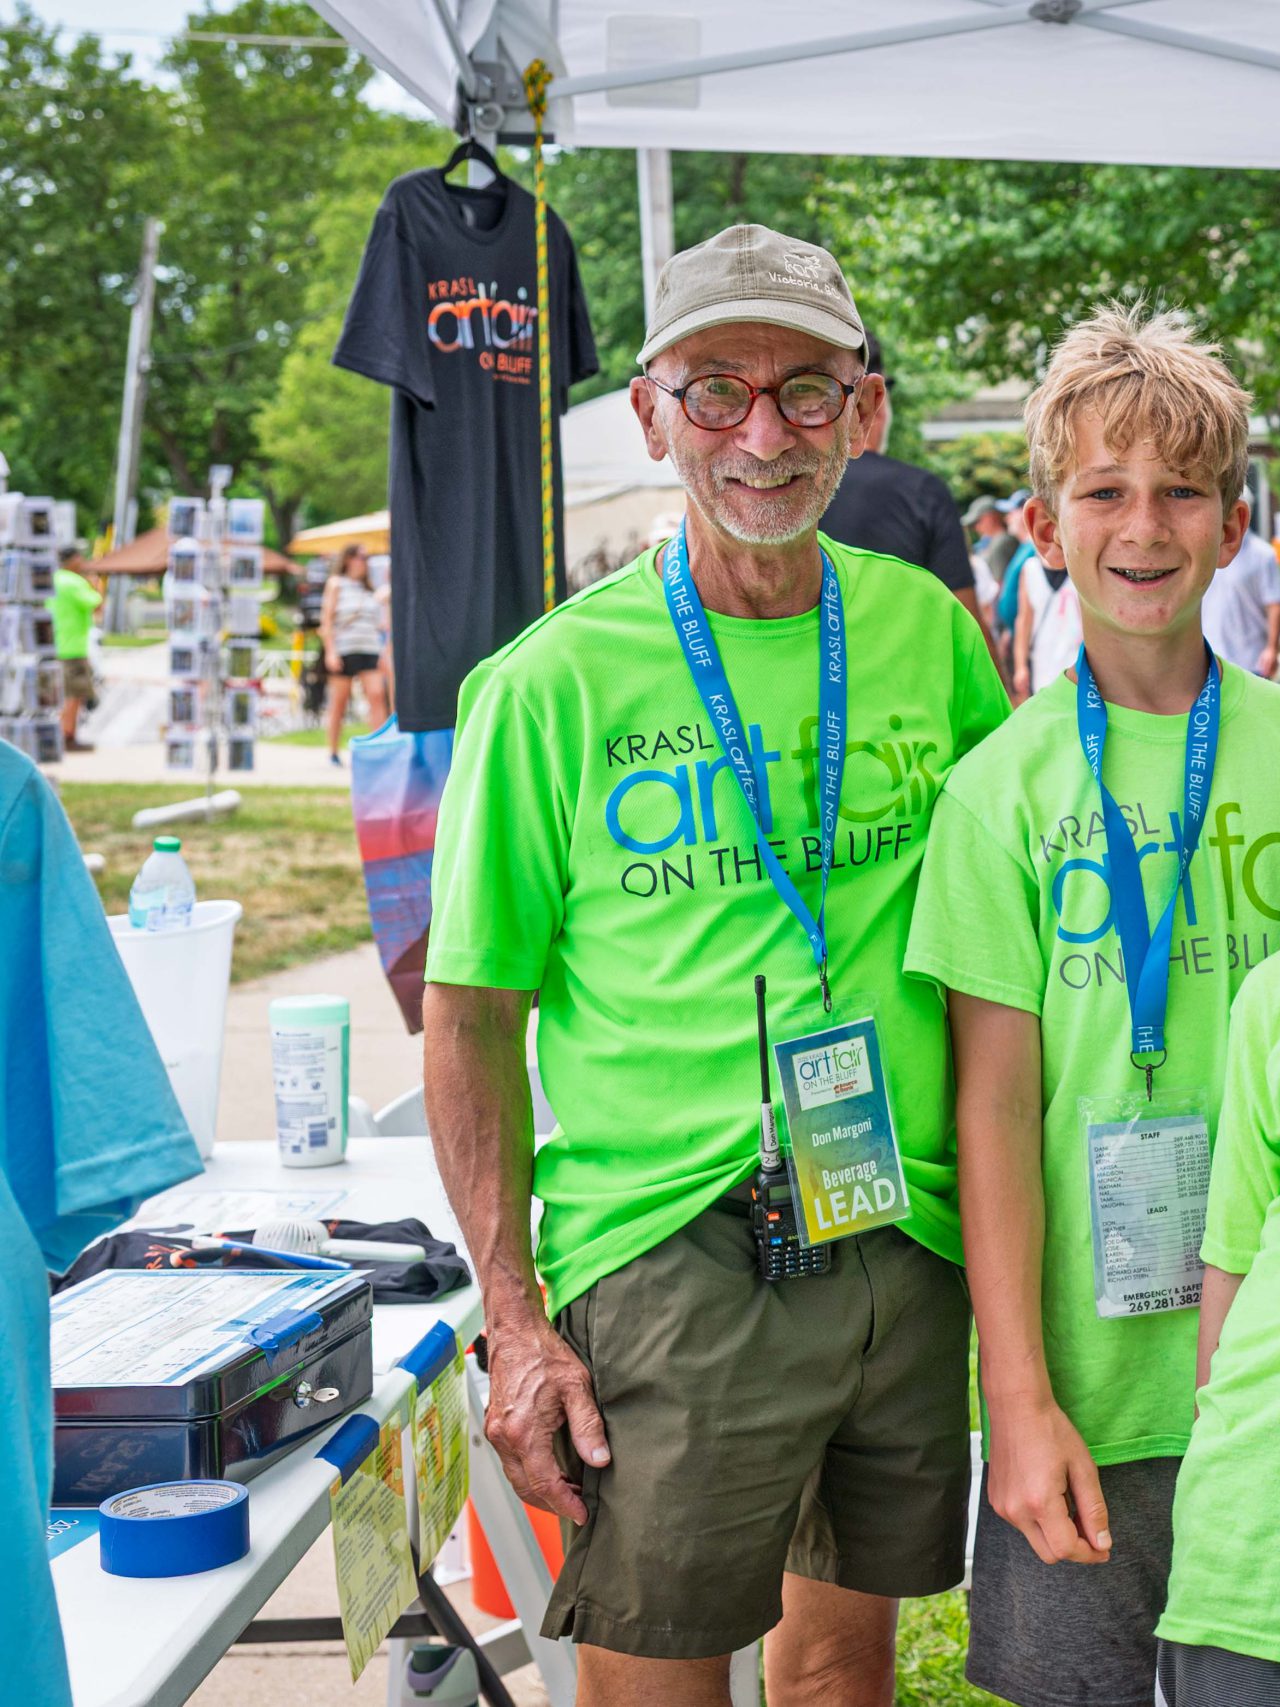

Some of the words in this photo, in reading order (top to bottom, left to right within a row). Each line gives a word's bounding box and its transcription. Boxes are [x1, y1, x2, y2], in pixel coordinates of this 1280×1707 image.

[428, 277, 477, 300] KRASL
[667, 560, 683, 586] ON
[671, 585, 694, 618] THE
[827, 602, 840, 632] art
[682, 619, 712, 667] BLUFF
[829, 634, 841, 684] KRASL
[709, 694, 738, 744] KRASL
[826, 709, 841, 761] BLUFF
[1193, 711, 1210, 738] ON
[606, 723, 714, 768] KRASL
[1191, 742, 1208, 770] THE
[605, 724, 782, 856] art
[826, 765, 839, 797] THE
[1188, 772, 1204, 822] BLUFF
[1040, 802, 1161, 863] KRASL
[621, 854, 696, 899] ON
[1059, 946, 1126, 989] ON
[1167, 936, 1214, 976] HE
[800, 1050, 831, 1080] art
[832, 1042, 863, 1073] fair
[803, 1080, 818, 1091] ON
[819, 1072, 834, 1087] THE
[835, 1067, 858, 1082] BLUFF
[812, 1132, 832, 1148] Don
[832, 1117, 873, 1142] Margoni
[1140, 1131, 1161, 1140] STAFF
[822, 1159, 878, 1191] Beverage
[814, 1177, 897, 1231] LEAD
[1147, 1206, 1168, 1215] LEADS
[1123, 1288, 1172, 1302] EMERGENCY
[1174, 1286, 1180, 1294] &
[1181, 1282, 1203, 1292] SAFET
[1129, 1292, 1202, 1313] 269.281.382
